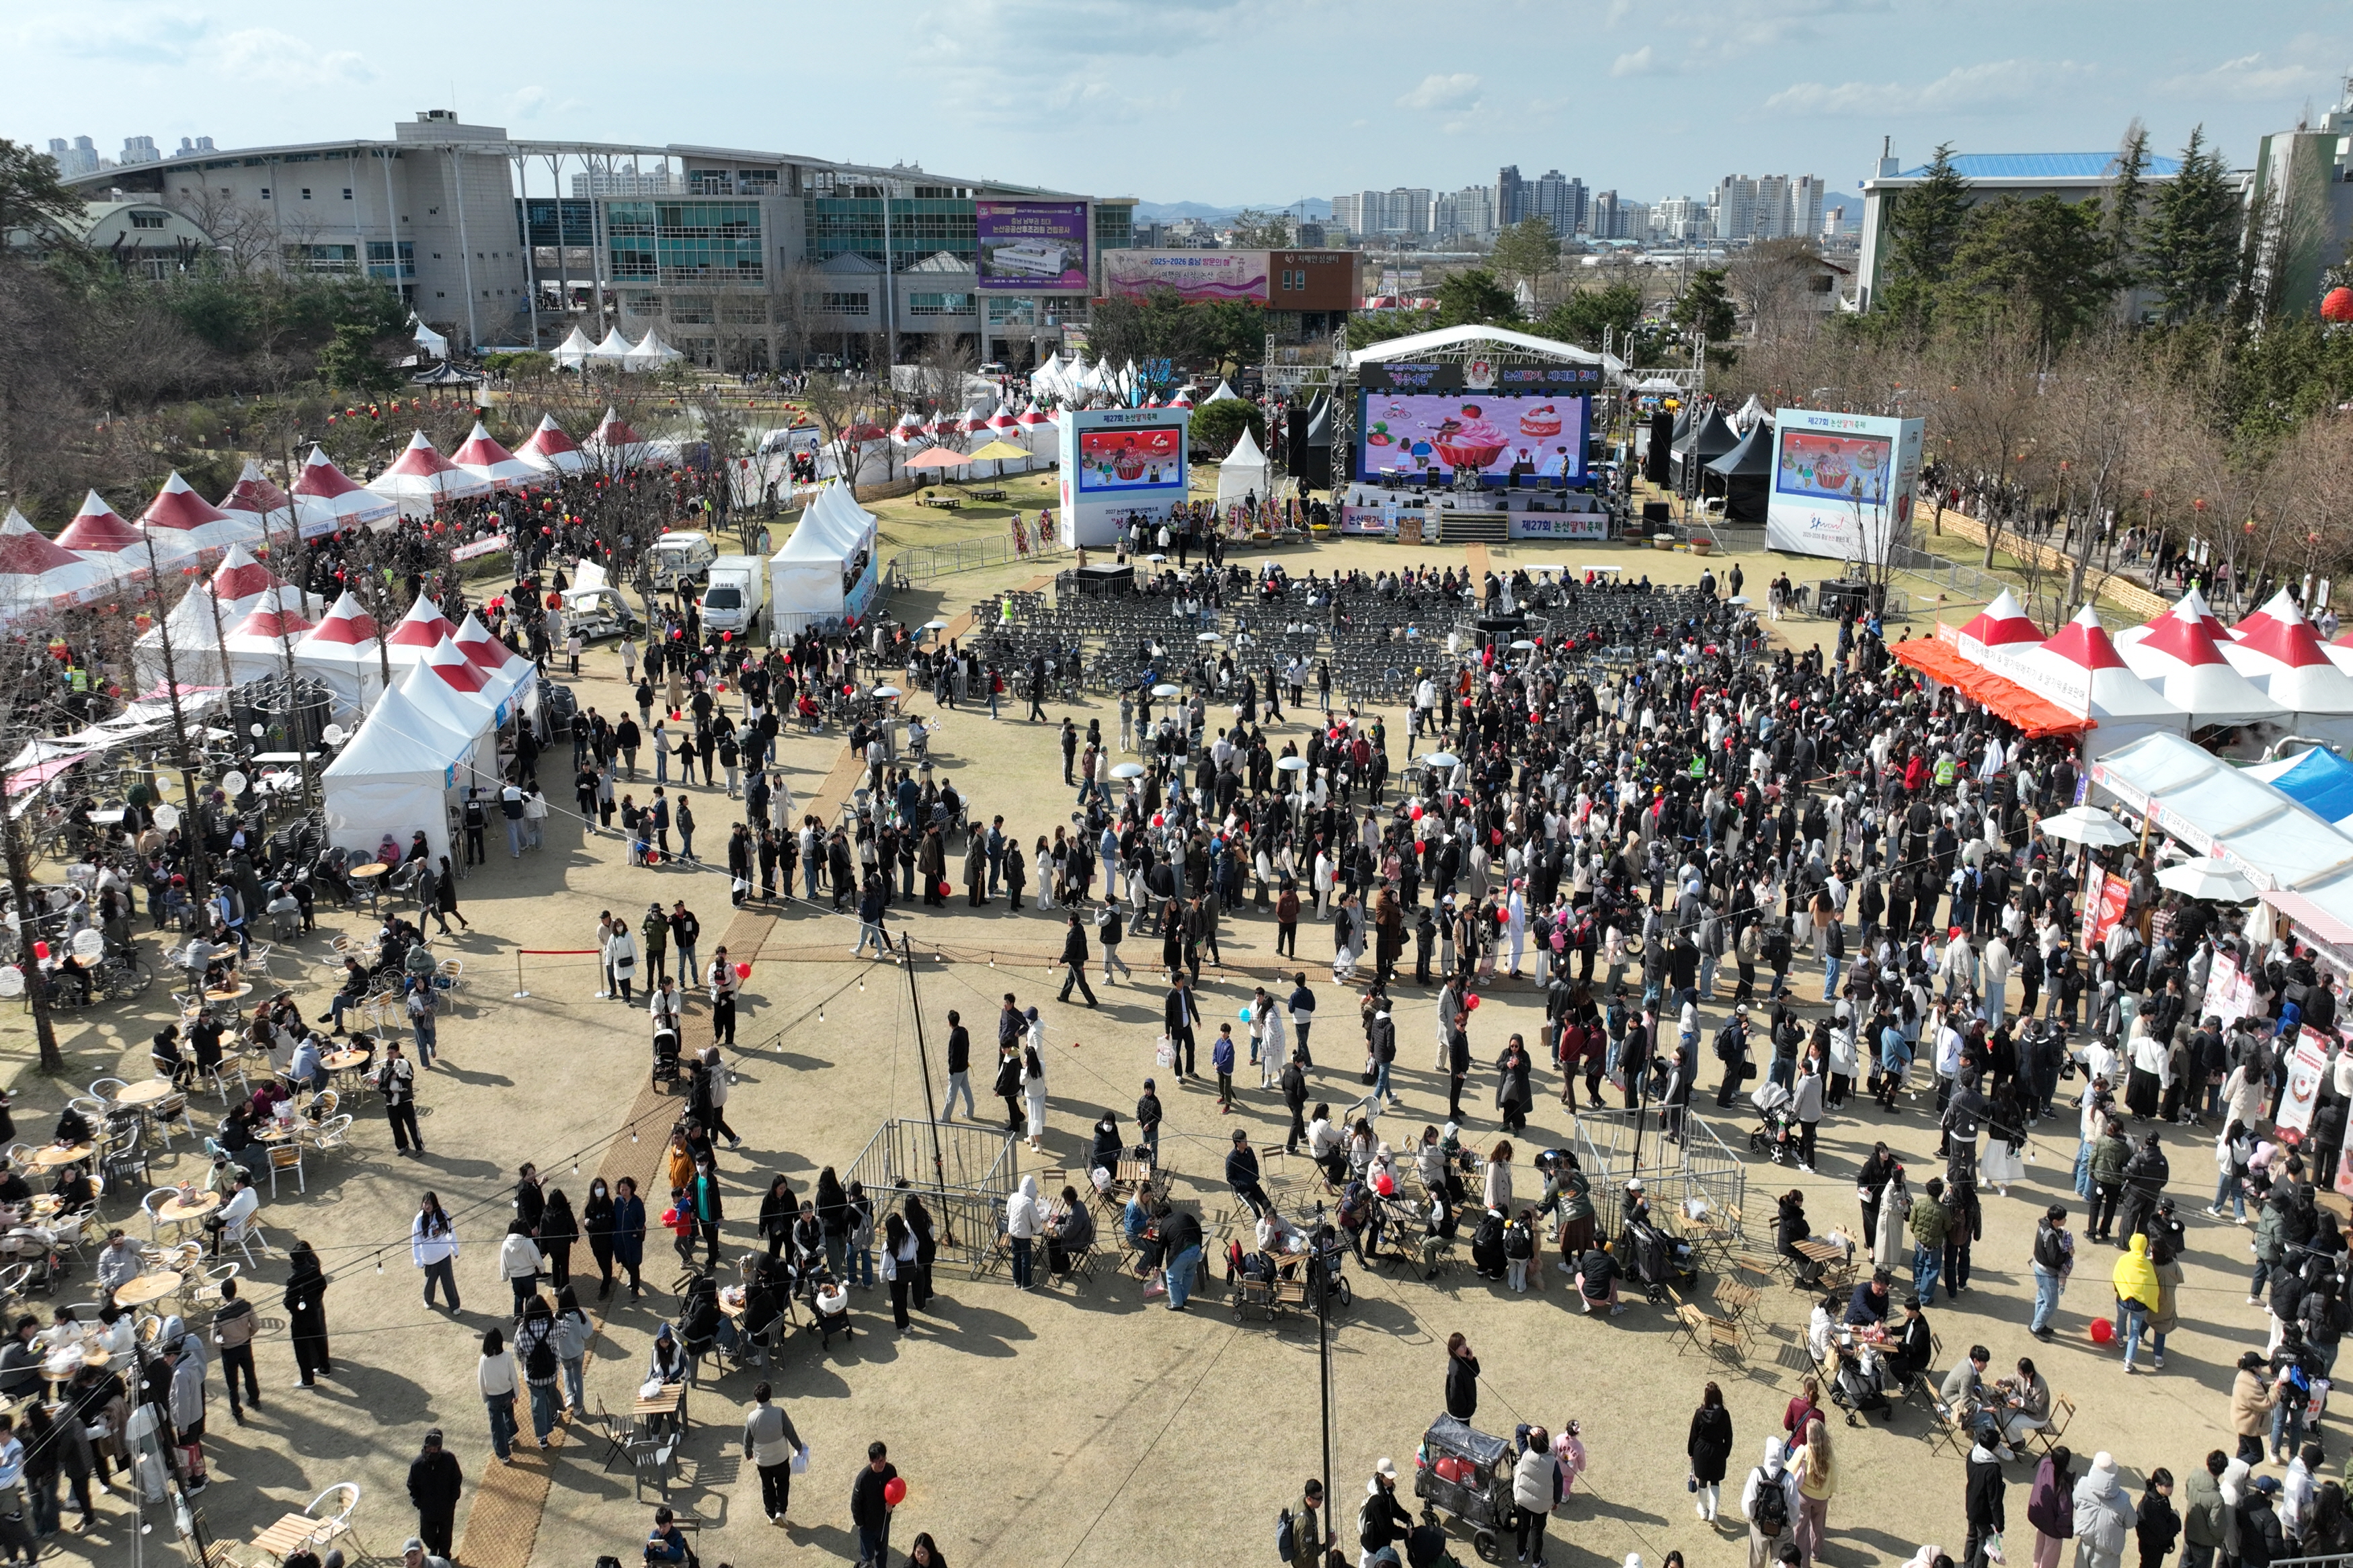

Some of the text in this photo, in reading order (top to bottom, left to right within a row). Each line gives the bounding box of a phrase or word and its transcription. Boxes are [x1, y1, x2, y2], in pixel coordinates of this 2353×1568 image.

[993, 226, 1070, 234] 논산공공산후조리원 건립공사
[1188, 258, 1201, 266] 충남
[1203, 258, 1222, 266] 방문의
[1223, 258, 1230, 267] 해
[1298, 255, 1339, 263] 치매안심센터
[1161, 272, 1181, 280] 여행의
[1200, 272, 1213, 280] 논산
[1504, 370, 1546, 382] 논산딸기,
[1548, 370, 1577, 382] 세계를
[1103, 413, 1158, 423] 제27회 논산딸기축제
[1808, 417, 1866, 429] 제27회 논산딸기축제
[1521, 520, 1603, 534] 제27회 논산딸기축제
[1997, 654, 2002, 663] &
[2003, 656, 2038, 679] 딸기떡메치기
[2038, 673, 2043, 681] &
[2044, 674, 2085, 702] 딸기떡홍보판매
[515, 679, 531, 703] 프레스센터
[2106, 886, 2127, 899] OMELETTE
[2110, 882, 2126, 893] CREAM
